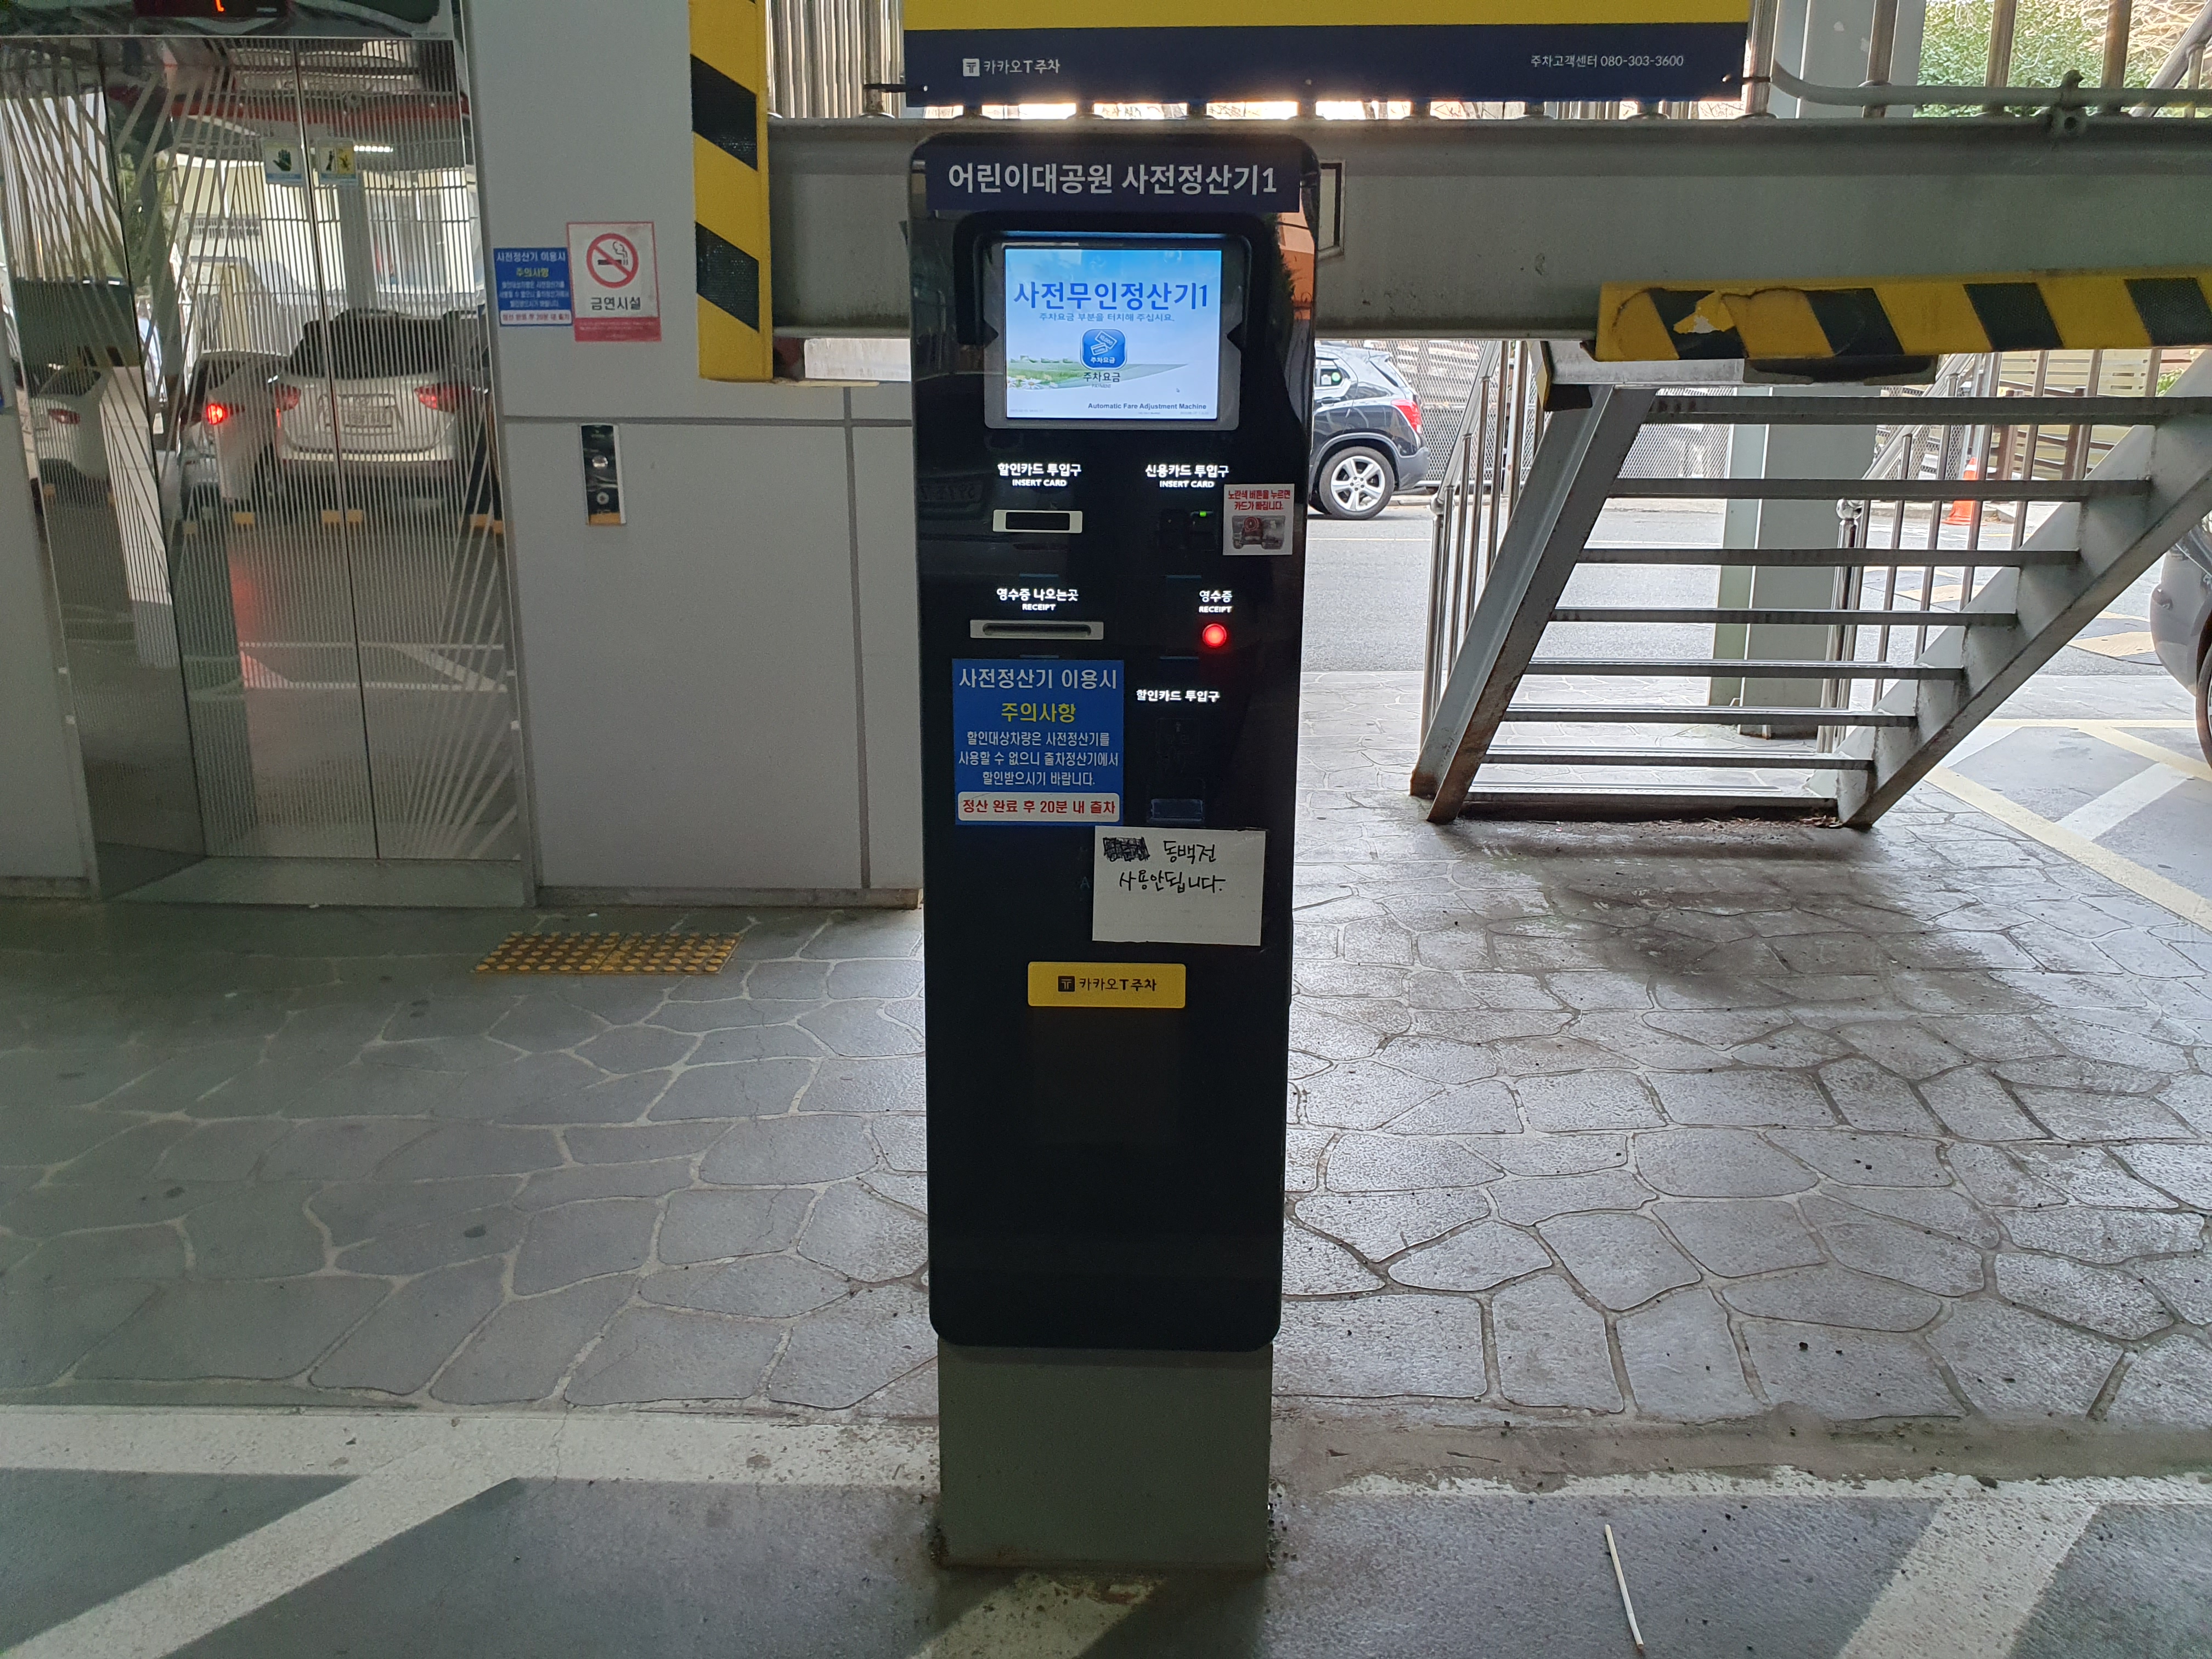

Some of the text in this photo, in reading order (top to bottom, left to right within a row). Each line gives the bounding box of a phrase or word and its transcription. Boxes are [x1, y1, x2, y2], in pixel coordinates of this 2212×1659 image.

[1531, 55, 1684, 68] 주차고객센터 080-303-3600
[949, 164, 1277, 195] 어린이대공원 사전정산기1
[1013, 281, 1207, 311] 사전무인정산기1
[590, 297, 641, 311] 금연시설
[1039, 313, 1075, 321] 주차요금
[1077, 313, 1104, 321] 부분을
[1107, 313, 1134, 321] 터치해
[1083, 372, 1120, 382] 주차요금
[997, 462, 1081, 477] 할인카드 투입구
[1145, 464, 1229, 478] 신용카드 투입구
[1012, 479, 1067, 487] INSERT CARD
[1159, 480, 1215, 488] INSERT CARD
[1228, 490, 1248, 499] 노란색
[1271, 489, 1290, 499] 누르면
[1234, 501, 1254, 510] 카드가
[996, 588, 1079, 602] 영수증 나오는곳
[1199, 590, 1232, 603] 영수증
[959, 668, 1117, 689] 사전정산기 이용시
[1136, 689, 1221, 702] 할인카드 투입구
[1001, 703, 1076, 723] 주의사항
[967, 731, 1109, 747] 할인대상차량은 사전정산기를
[959, 751, 1119, 766] 사용할 수 없으니 출차정산기에서
[983, 771, 1096, 786] 할인받으시기 바랍니다.
[963, 799, 1115, 814] 정산 완료 후 20분 내 출차
[1163, 840, 1216, 865] 동백전
